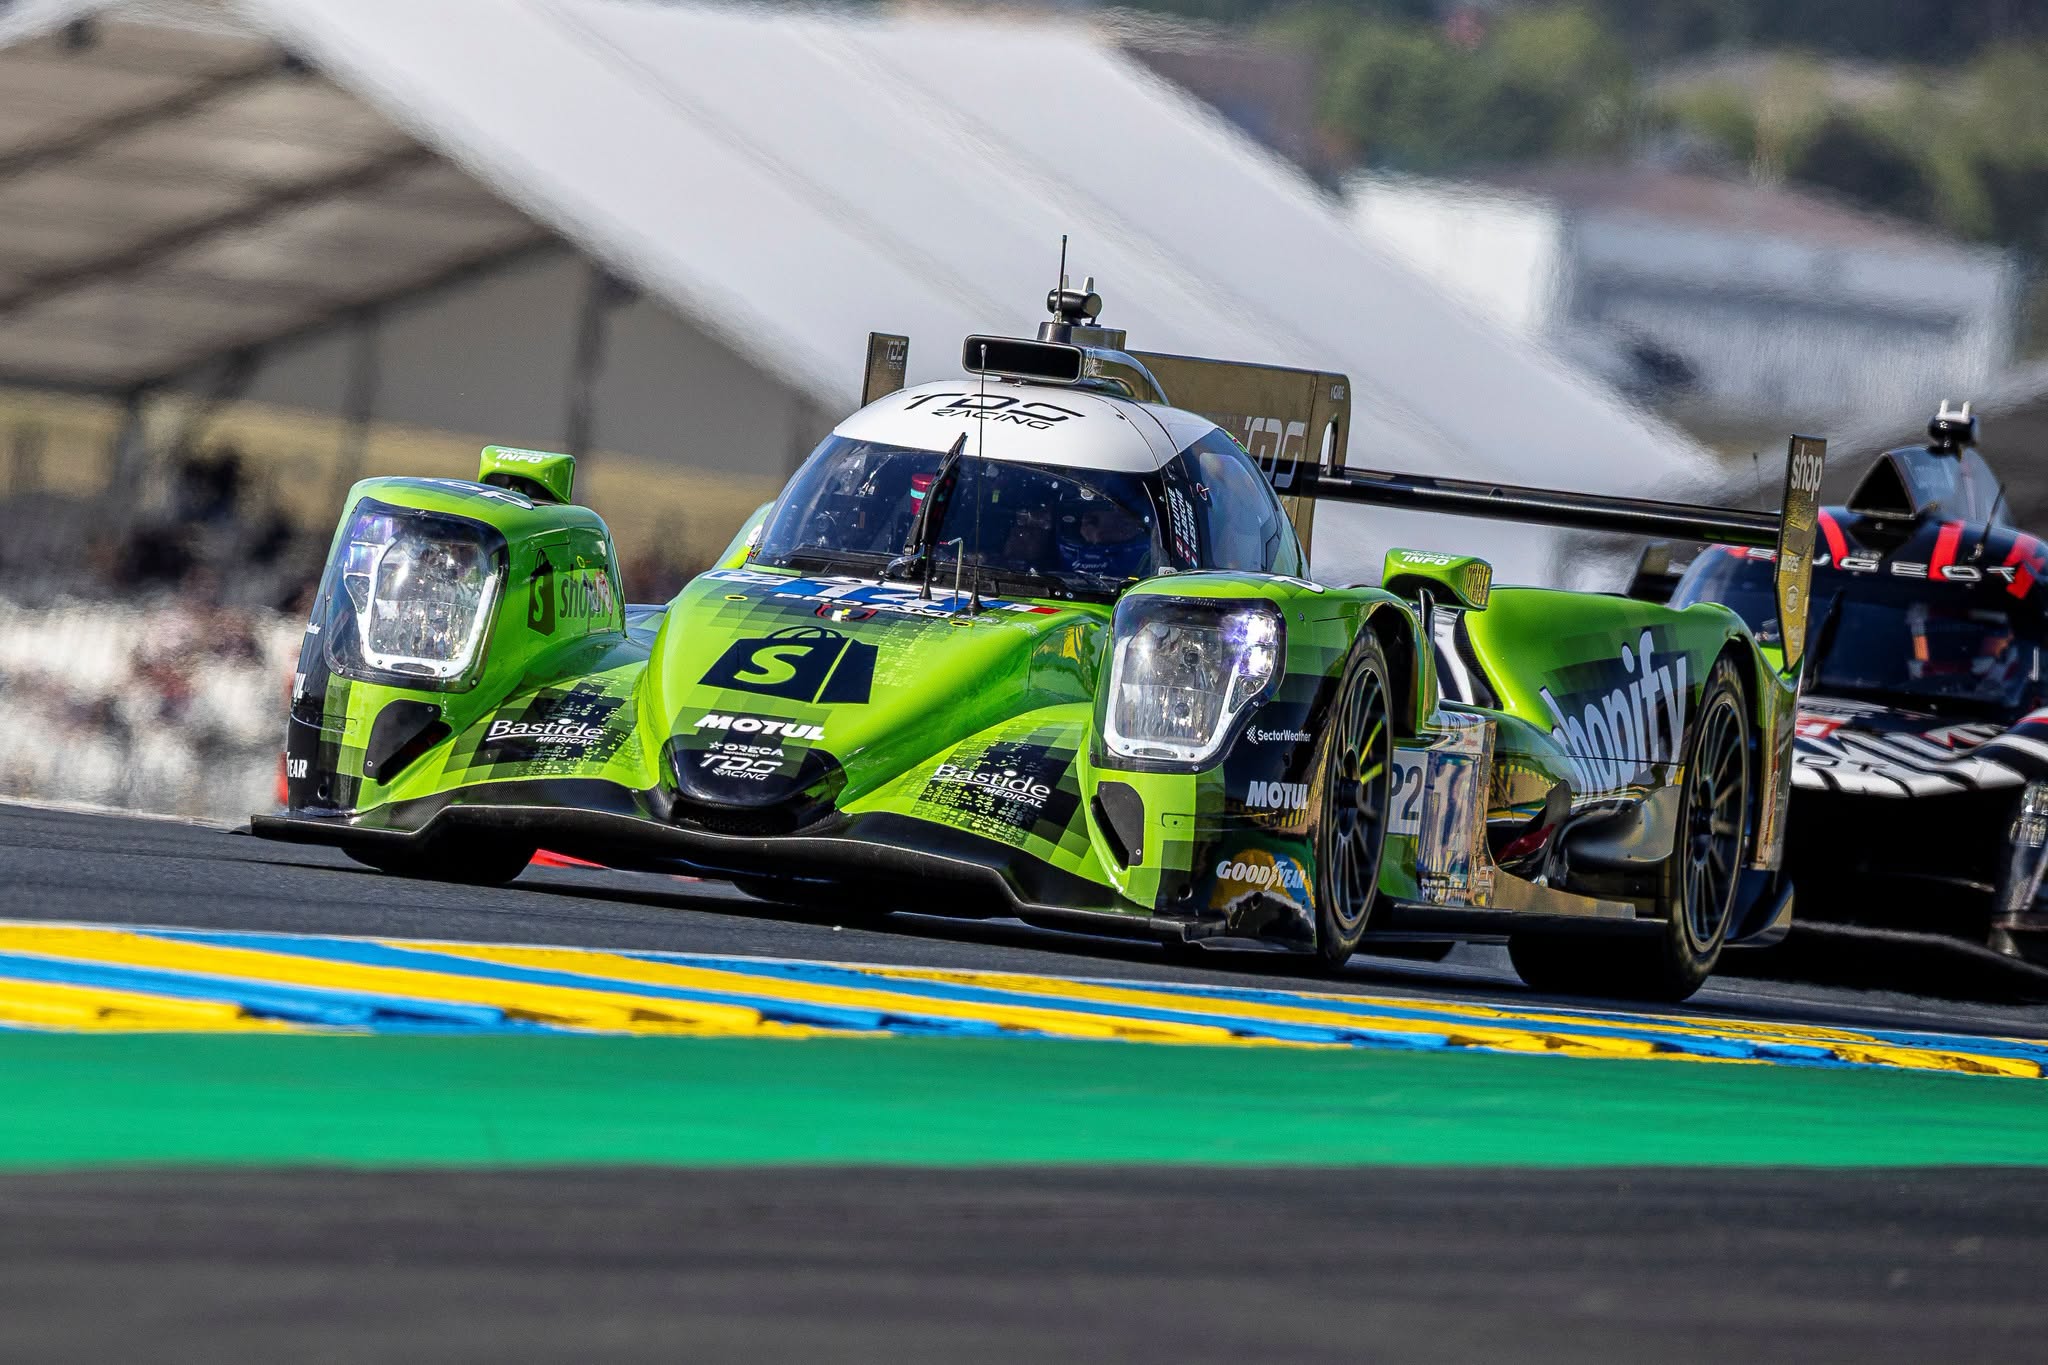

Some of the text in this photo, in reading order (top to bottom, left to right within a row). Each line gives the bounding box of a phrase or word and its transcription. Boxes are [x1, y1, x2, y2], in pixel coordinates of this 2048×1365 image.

[904, 392, 1086, 422] TDS
[931, 408, 1054, 430] RACING
[496, 452, 543, 464] INFO
[1791, 443, 1823, 502] shop
[1402, 555, 1450, 566] INFO
[774, 592, 863, 605] PRO
[733, 644, 815, 685] S
[489, 718, 603, 740] Bastide
[694, 713, 826, 741] MOTUL
[1257, 729, 1311, 742] SectorWeather
[723, 743, 784, 757] ORECA
[700, 754, 783, 774] TDS
[712, 768, 769, 781] RACING
[934, 764, 1051, 798] Bastide
[983, 786, 1043, 808] MEDICAL
[1246, 780, 1309, 810] MOTUL
[1215, 860, 1306, 891] GOODYEAR
